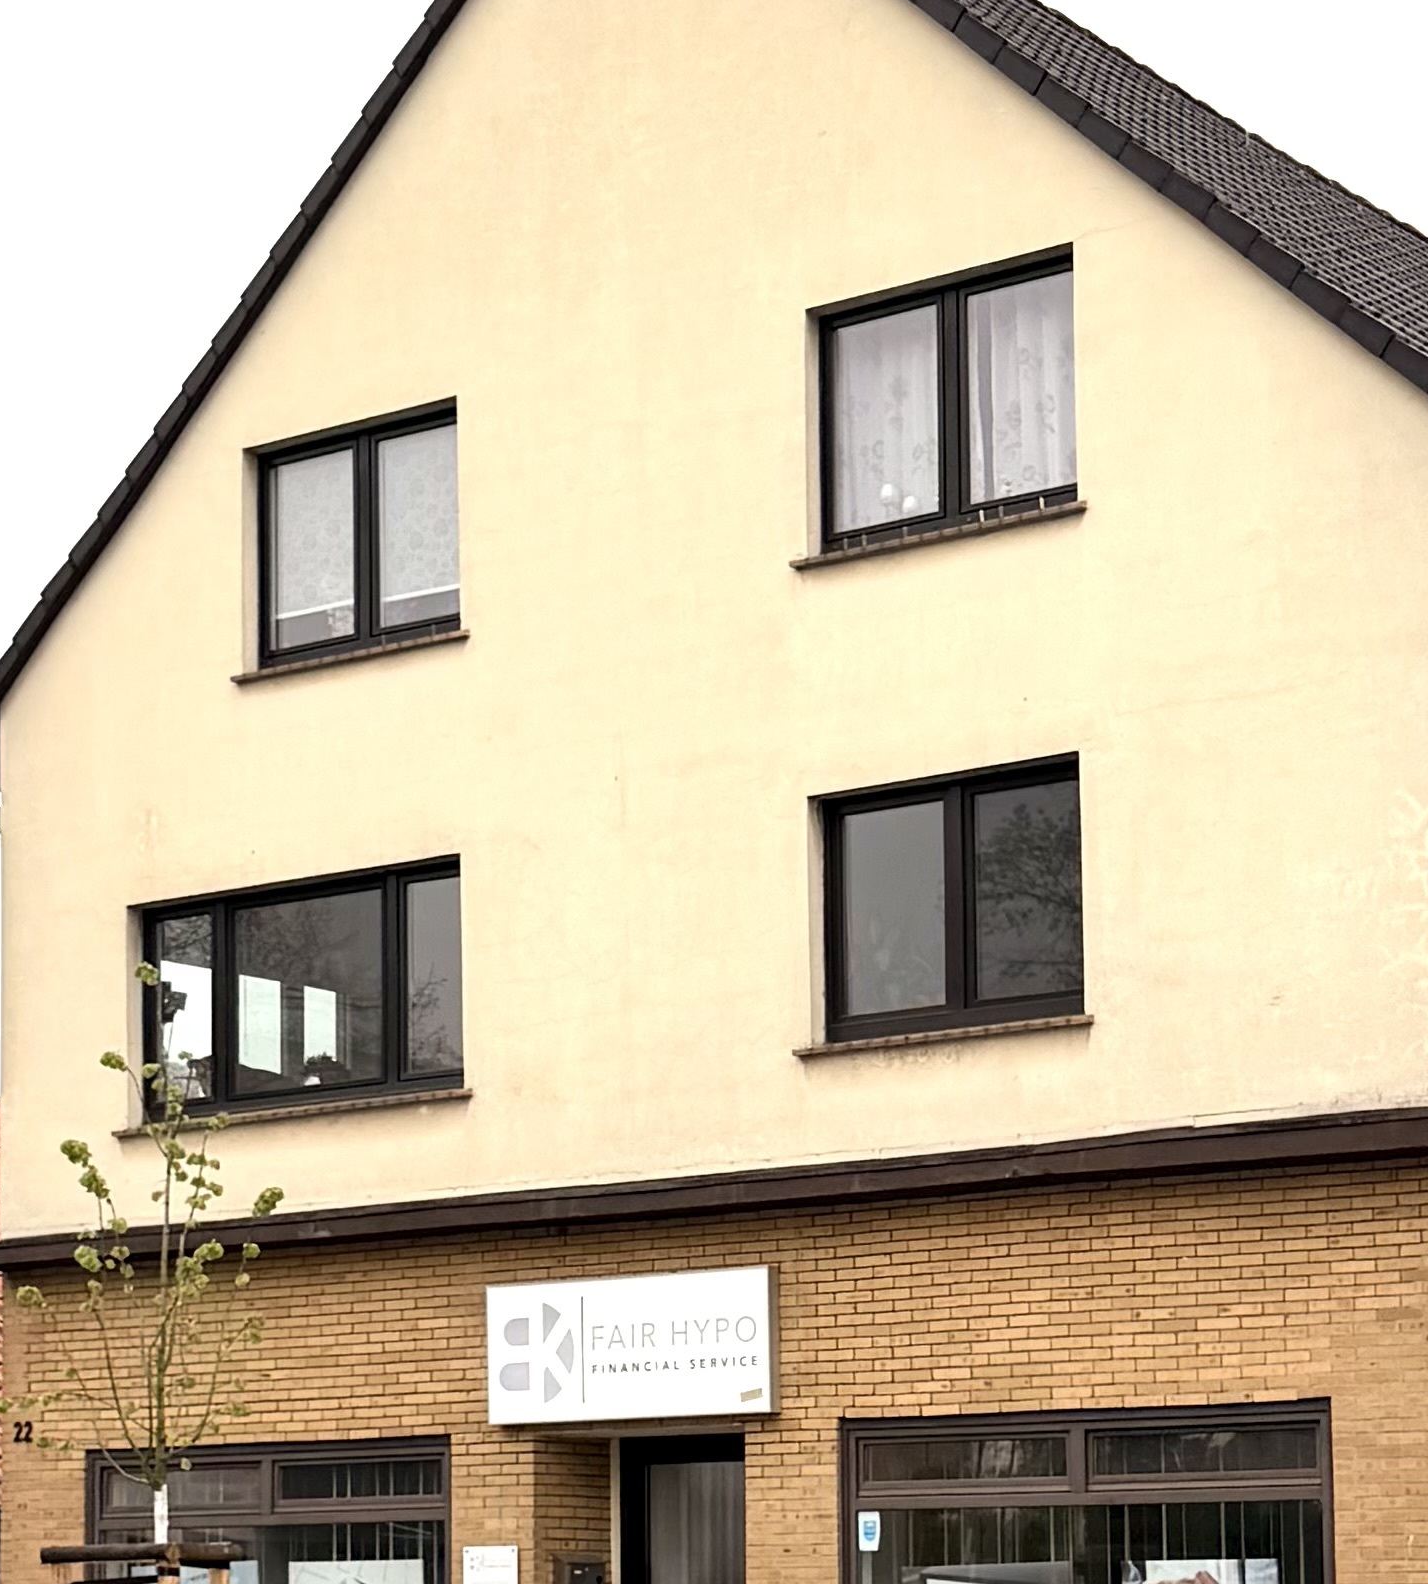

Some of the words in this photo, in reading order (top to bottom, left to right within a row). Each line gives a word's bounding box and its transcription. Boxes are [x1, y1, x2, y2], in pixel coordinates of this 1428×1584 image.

[591, 1321, 656, 1351] FAIR
[671, 1315, 757, 1346] HYPO
[591, 1360, 680, 1374] FINANCIAL
[689, 1354, 758, 1370] SERVICE
[13, 1420, 34, 1443] 22
